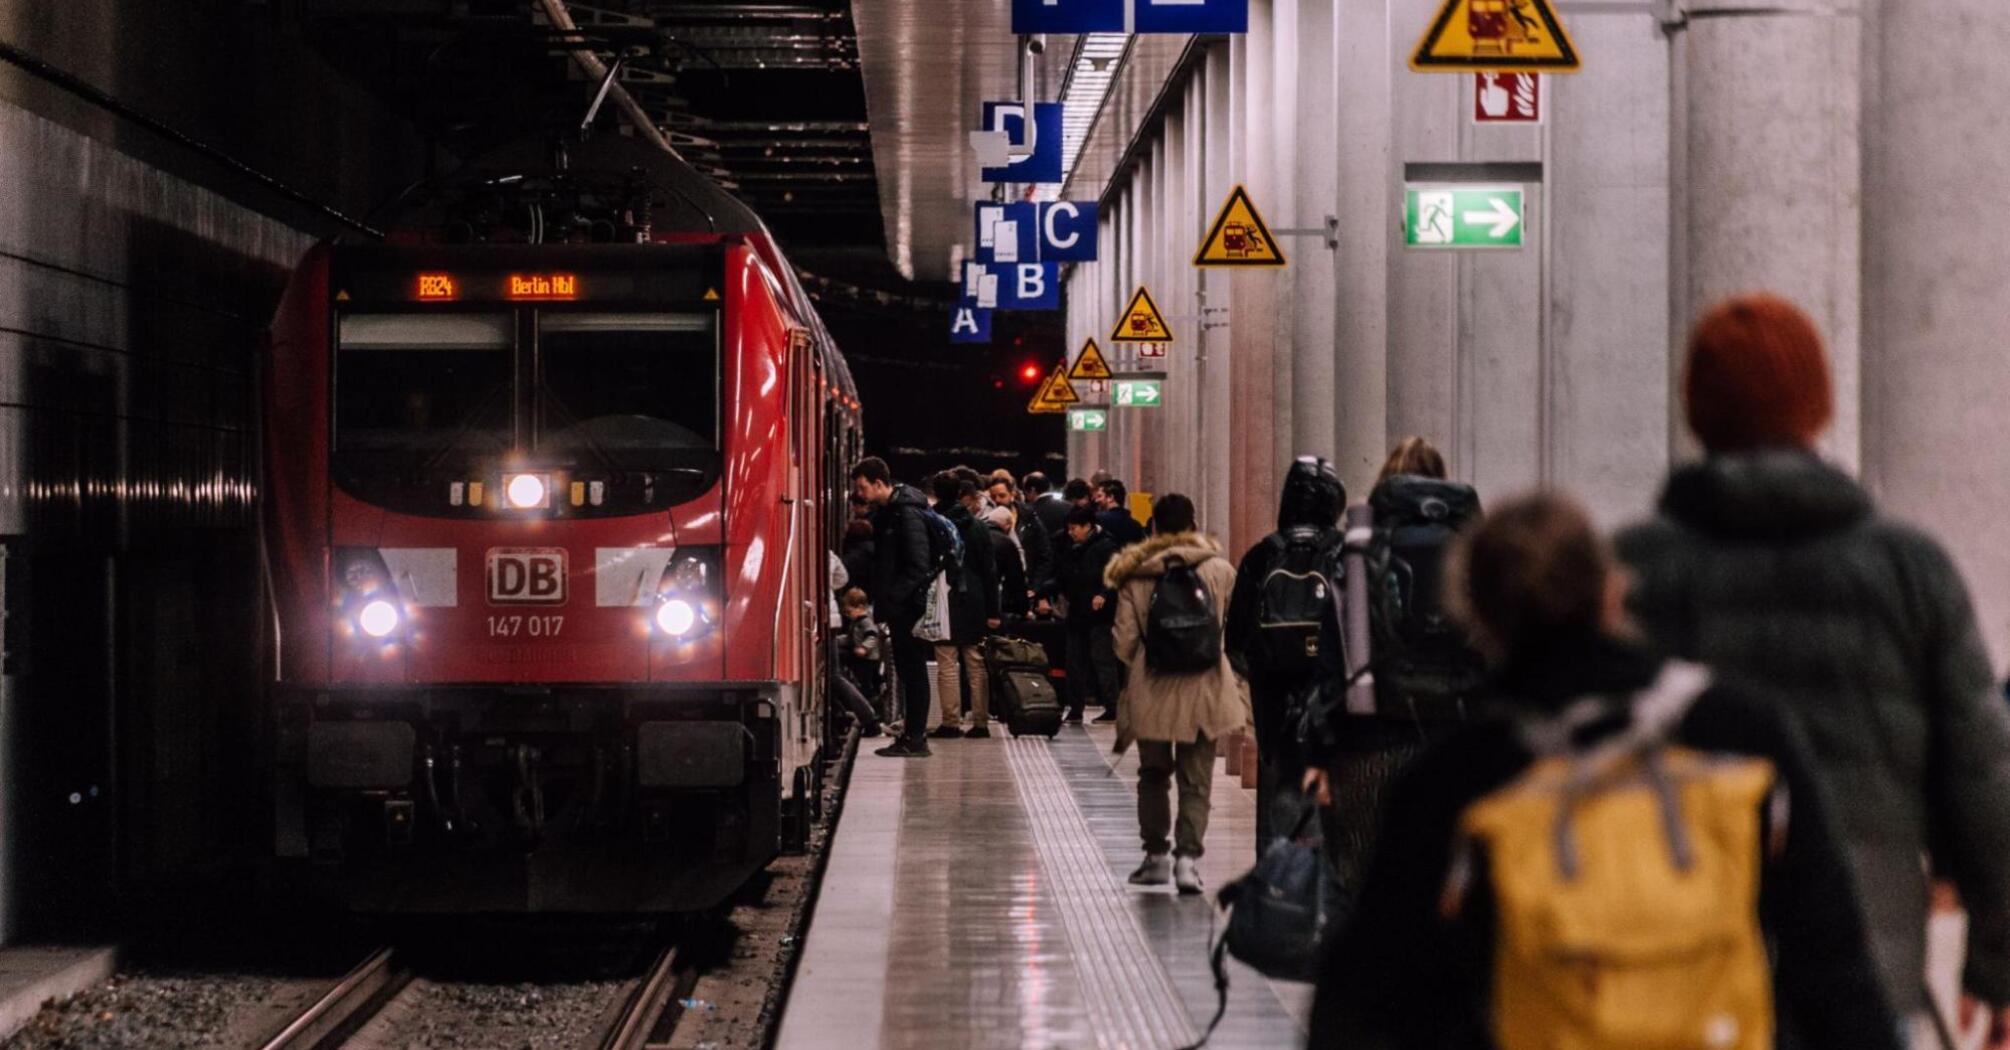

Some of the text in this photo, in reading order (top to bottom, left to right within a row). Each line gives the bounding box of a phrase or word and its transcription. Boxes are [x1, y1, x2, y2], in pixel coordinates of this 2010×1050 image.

[994, 105, 1037, 164] D
[1044, 202, 1080, 248] C
[419, 275, 452, 296] RB24
[511, 276, 550, 294] Berlin
[1017, 264, 1045, 299] B
[952, 308, 979, 334] A
[497, 558, 558, 596] DB
[487, 615, 564, 636] 147 017
